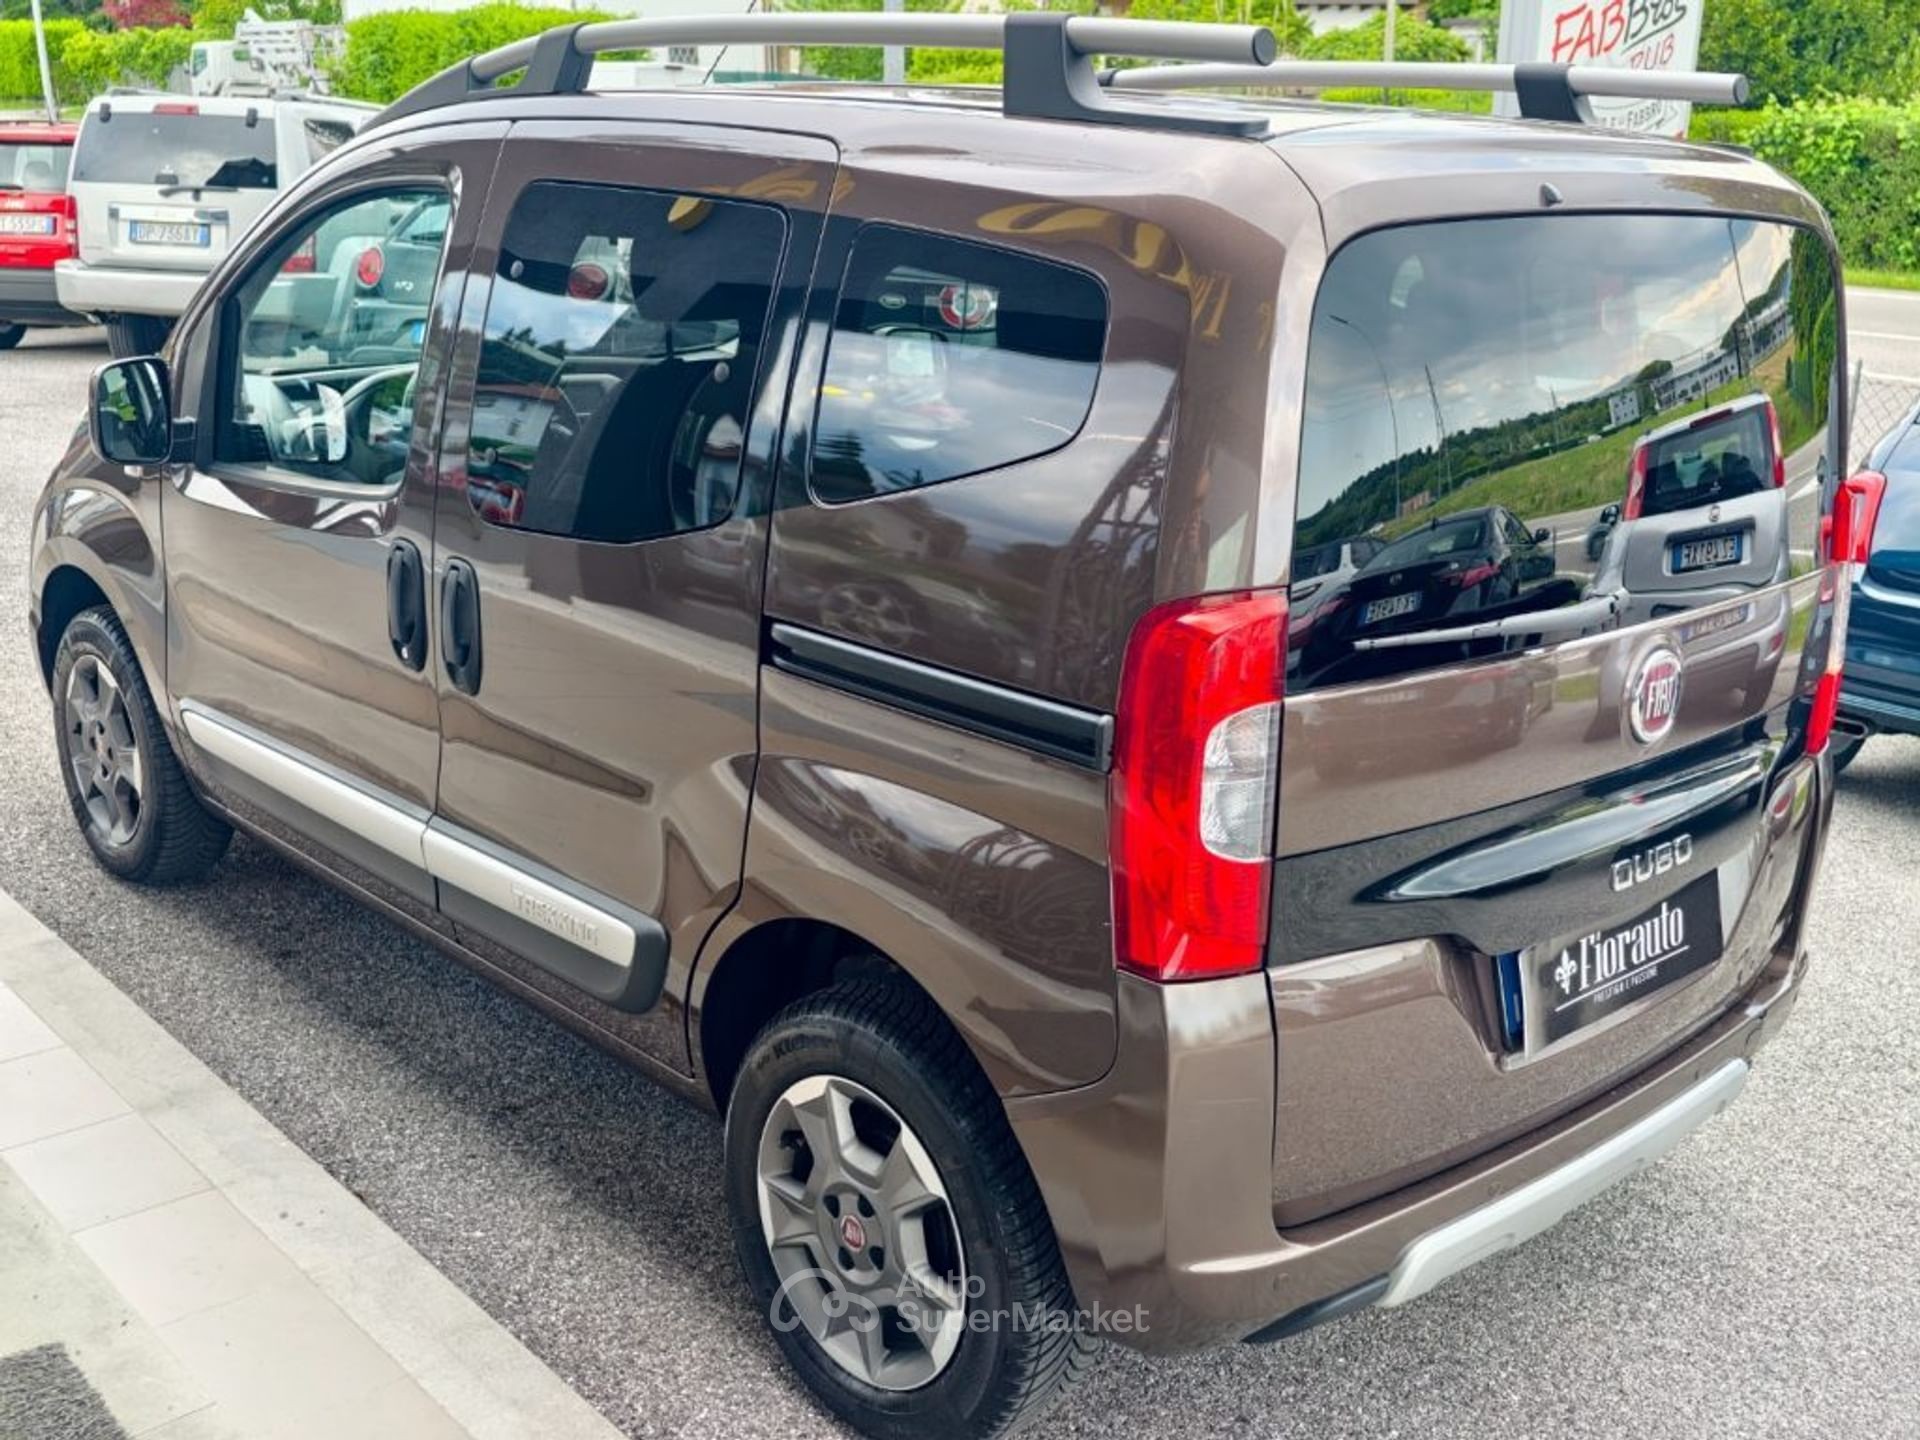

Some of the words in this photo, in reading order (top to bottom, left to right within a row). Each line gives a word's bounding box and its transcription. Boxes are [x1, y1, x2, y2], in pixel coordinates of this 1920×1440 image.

[1630, 33, 1675, 71] PUB
[1645, 676, 1678, 720] FIAT
[1611, 833, 1693, 892] QUBO
[1579, 902, 1684, 991] Fiorauto
